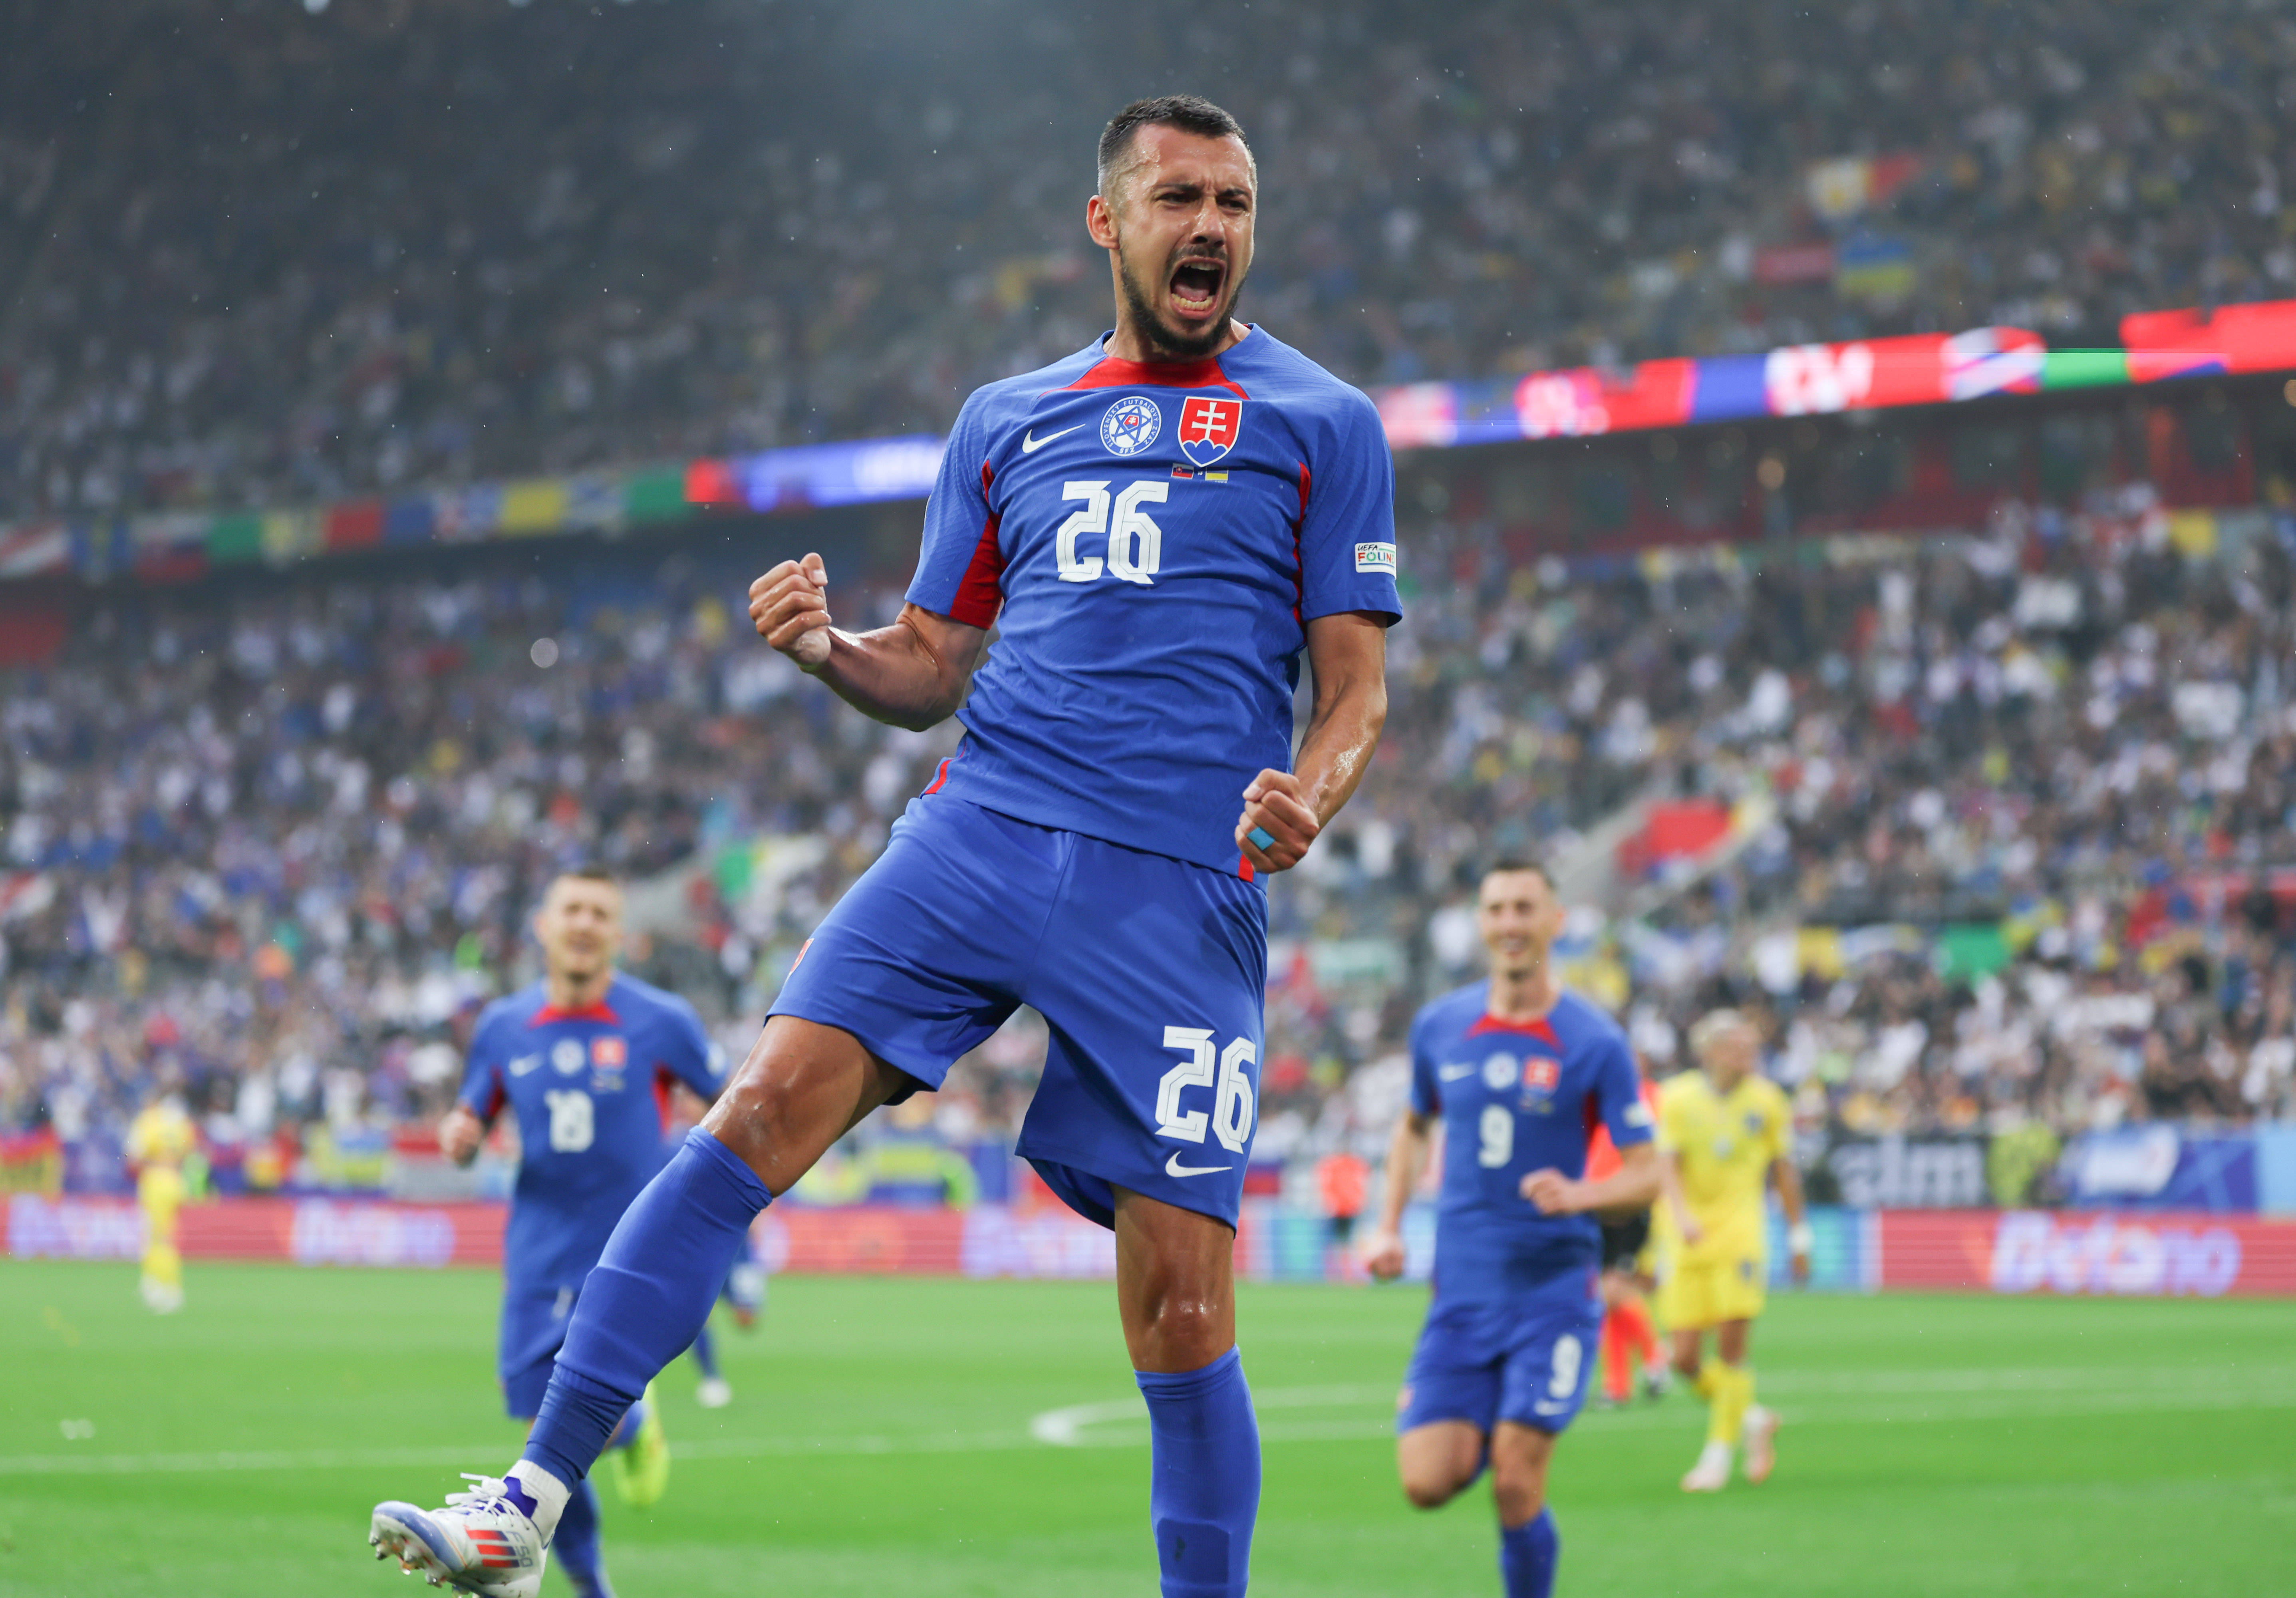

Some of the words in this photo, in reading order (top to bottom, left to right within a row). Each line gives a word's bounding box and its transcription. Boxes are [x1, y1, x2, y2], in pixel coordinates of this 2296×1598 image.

[1056, 480, 1169, 584] 26
[544, 1090, 594, 1153] 18
[1155, 1026, 1256, 1154] 26
[1478, 1104, 1514, 1169] 9
[1992, 1210, 2242, 1297] Betano
[1548, 1334, 1583, 1398] 9
